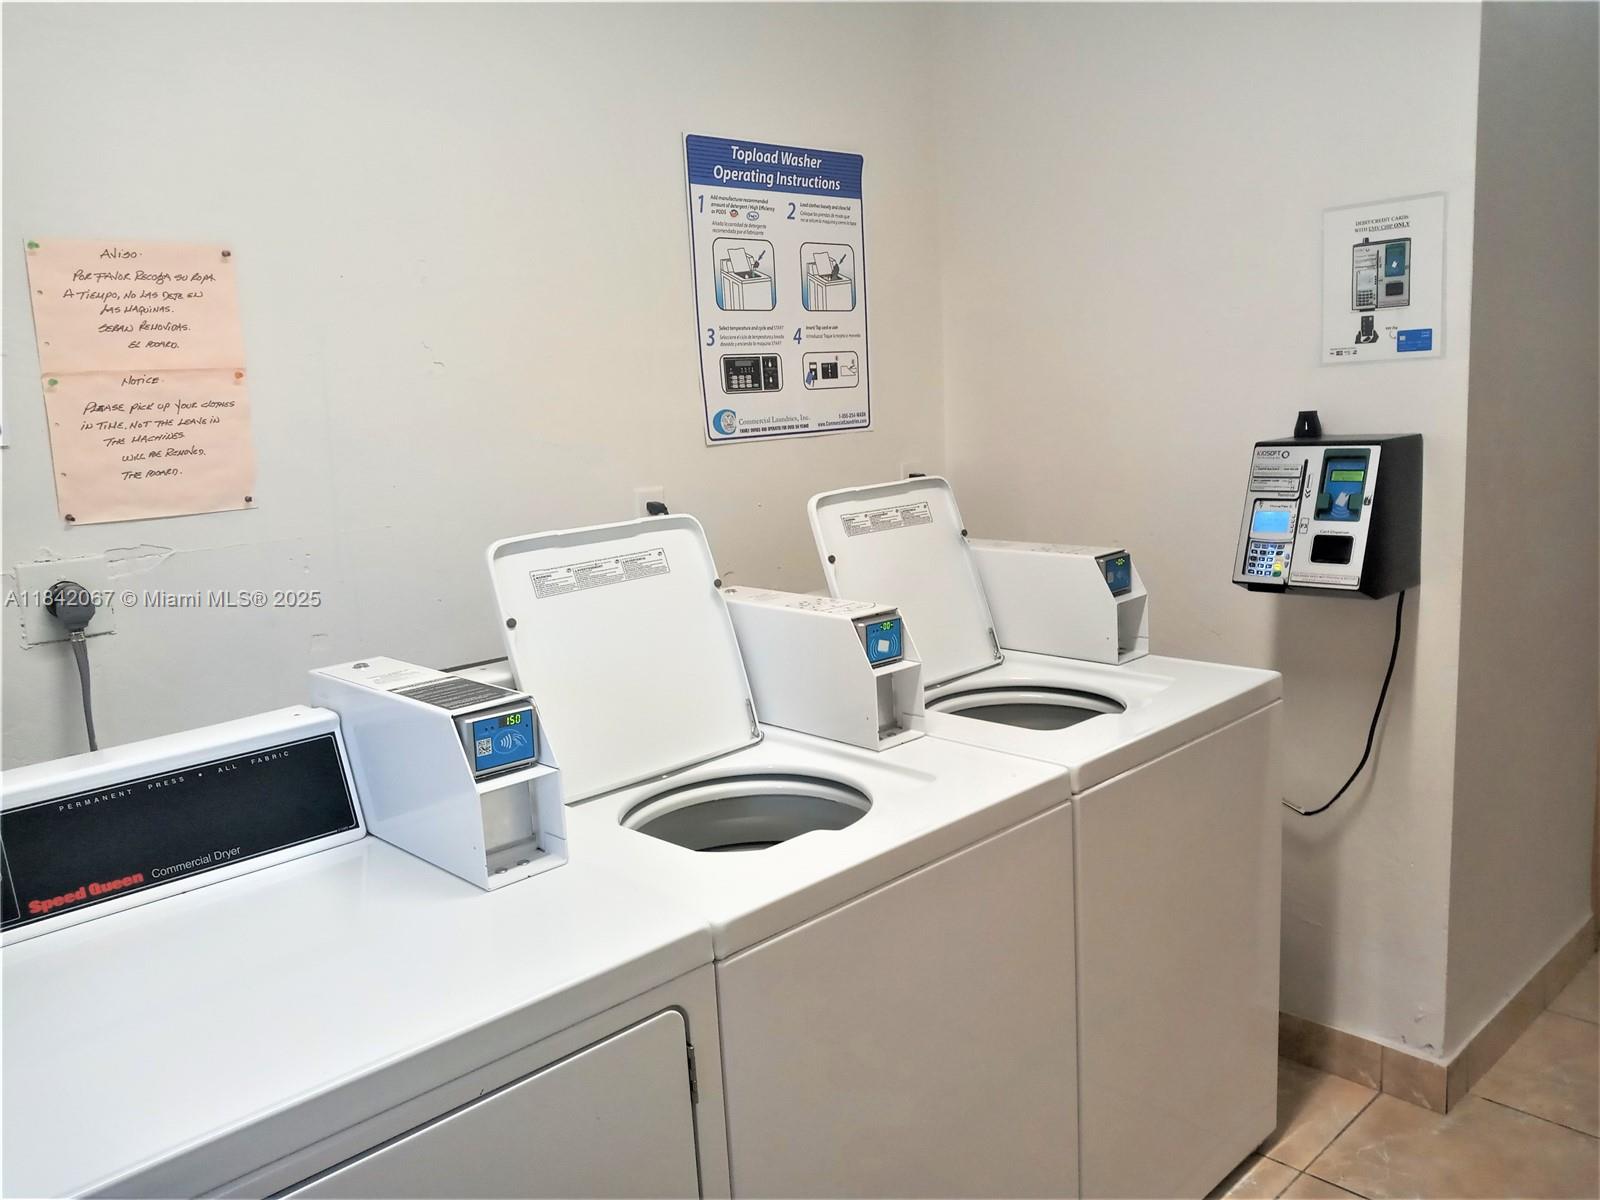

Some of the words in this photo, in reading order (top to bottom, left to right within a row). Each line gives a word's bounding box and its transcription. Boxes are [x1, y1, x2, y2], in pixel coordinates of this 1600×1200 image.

[731, 146, 779, 164] Topload
[780, 152, 822, 168] Washer
[714, 165, 774, 187] Operating
[776, 172, 841, 191] Instructions
[698, 194, 704, 213] 1
[787, 202, 796, 220] 2
[706, 328, 715, 346] 3
[793, 328, 802, 344] 4
[739, 416, 770, 425] Commercial
[58, 788, 133, 812] PERMANENT
[148, 776, 186, 790] PRESS
[217, 763, 238, 774] ALL
[251, 750, 290, 765] FABRIC
[28, 886, 87, 915] Speed
[88, 871, 144, 898] Queen
[152, 854, 212, 879] Commercial
[214, 845, 242, 862] Dryer
